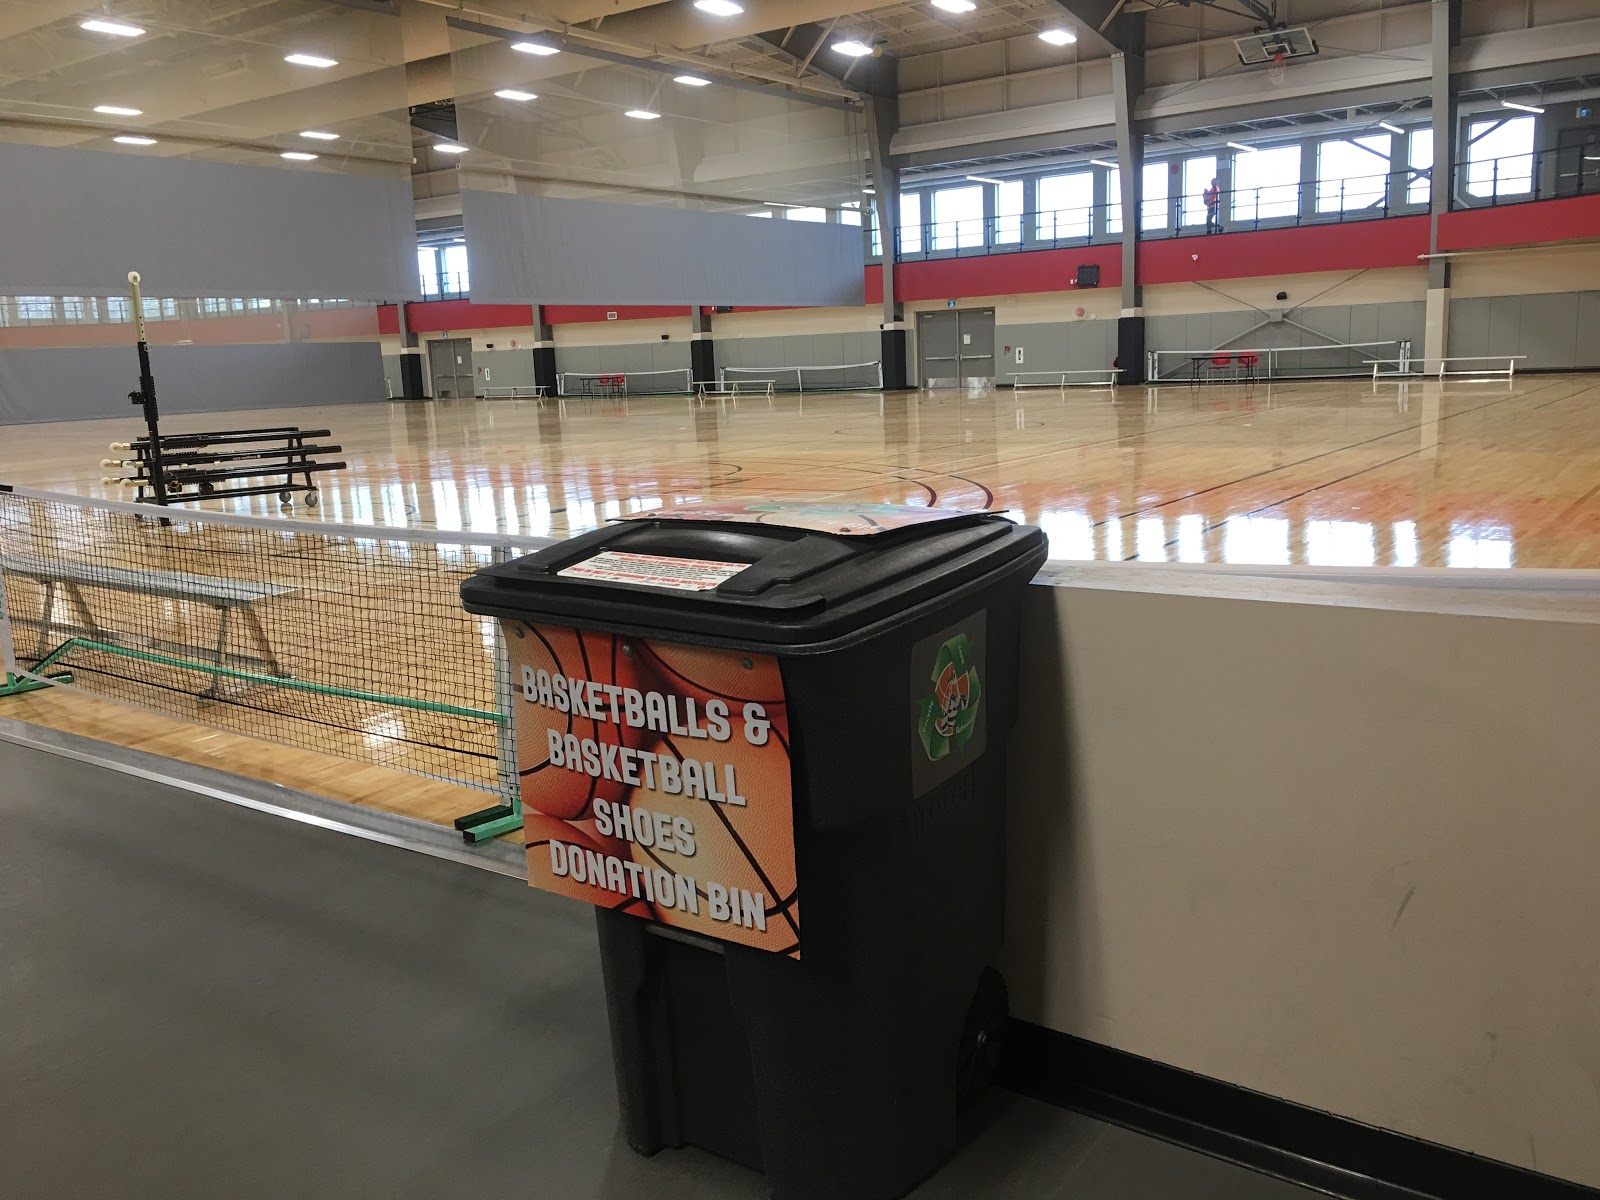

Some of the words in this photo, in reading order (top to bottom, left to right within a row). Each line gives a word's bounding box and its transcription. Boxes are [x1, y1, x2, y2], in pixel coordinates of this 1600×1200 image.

[520, 664, 731, 742] BASKETBALLS
[742, 702, 771, 746] &
[547, 728, 747, 807] BASKETBALL
[592, 797, 697, 857] SHOES
[550, 839, 699, 915] DONATION
[706, 882, 767, 932] BIN
